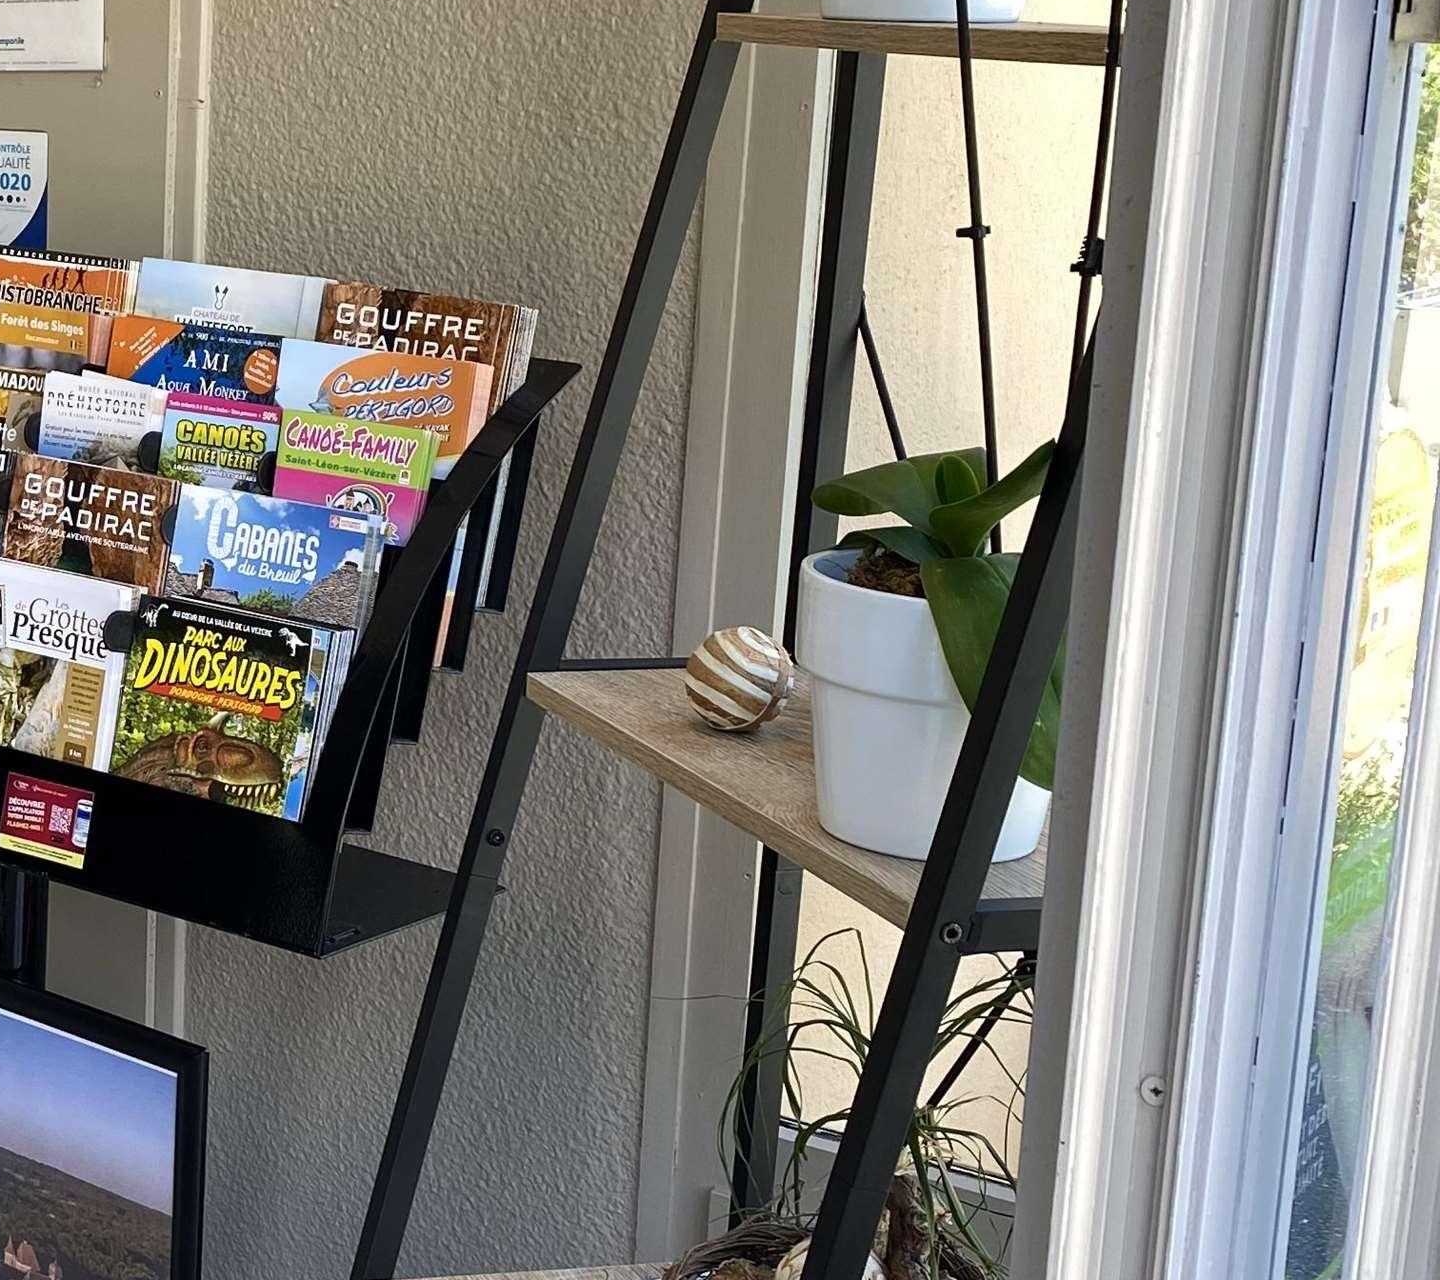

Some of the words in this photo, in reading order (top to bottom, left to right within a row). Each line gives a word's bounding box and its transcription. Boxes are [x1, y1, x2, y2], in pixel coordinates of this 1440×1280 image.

[30, 319, 48, 331] des
[50, 320, 85, 337] Singes
[336, 302, 484, 342] GOUFFRE
[333, 328, 352, 342] DE
[354, 332, 479, 363] PADIRAC
[330, 367, 453, 396] Couleurs
[46, 391, 147, 418] PRÉHISTOIRE
[176, 419, 266, 453] CANOËS
[285, 418, 418, 468] CANOË-FAMILY
[176, 443, 218, 465] VALLÉE
[284, 454, 397, 480] Saint-Léon-sur-Vézère
[24, 472, 157, 517] GOUFFRE
[20, 498, 38, 511] DE
[40, 502, 153, 542] PADIRAC
[207, 496, 320, 571] CABANES
[66, 531, 103, 547] AVENTURE
[103, 538, 150, 556] SOUTERRAINE
[238, 558, 258, 577] du
[258, 561, 304, 586] Breuil
[15, 599, 27, 611] de
[29, 597, 107, 638] Grottes
[172, 609, 182, 618] AU
[10, 611, 110, 661] Presque
[183, 625, 223, 649] PARC
[223, 635, 248, 653] AUX
[133, 638, 302, 710] DINOSAURES
